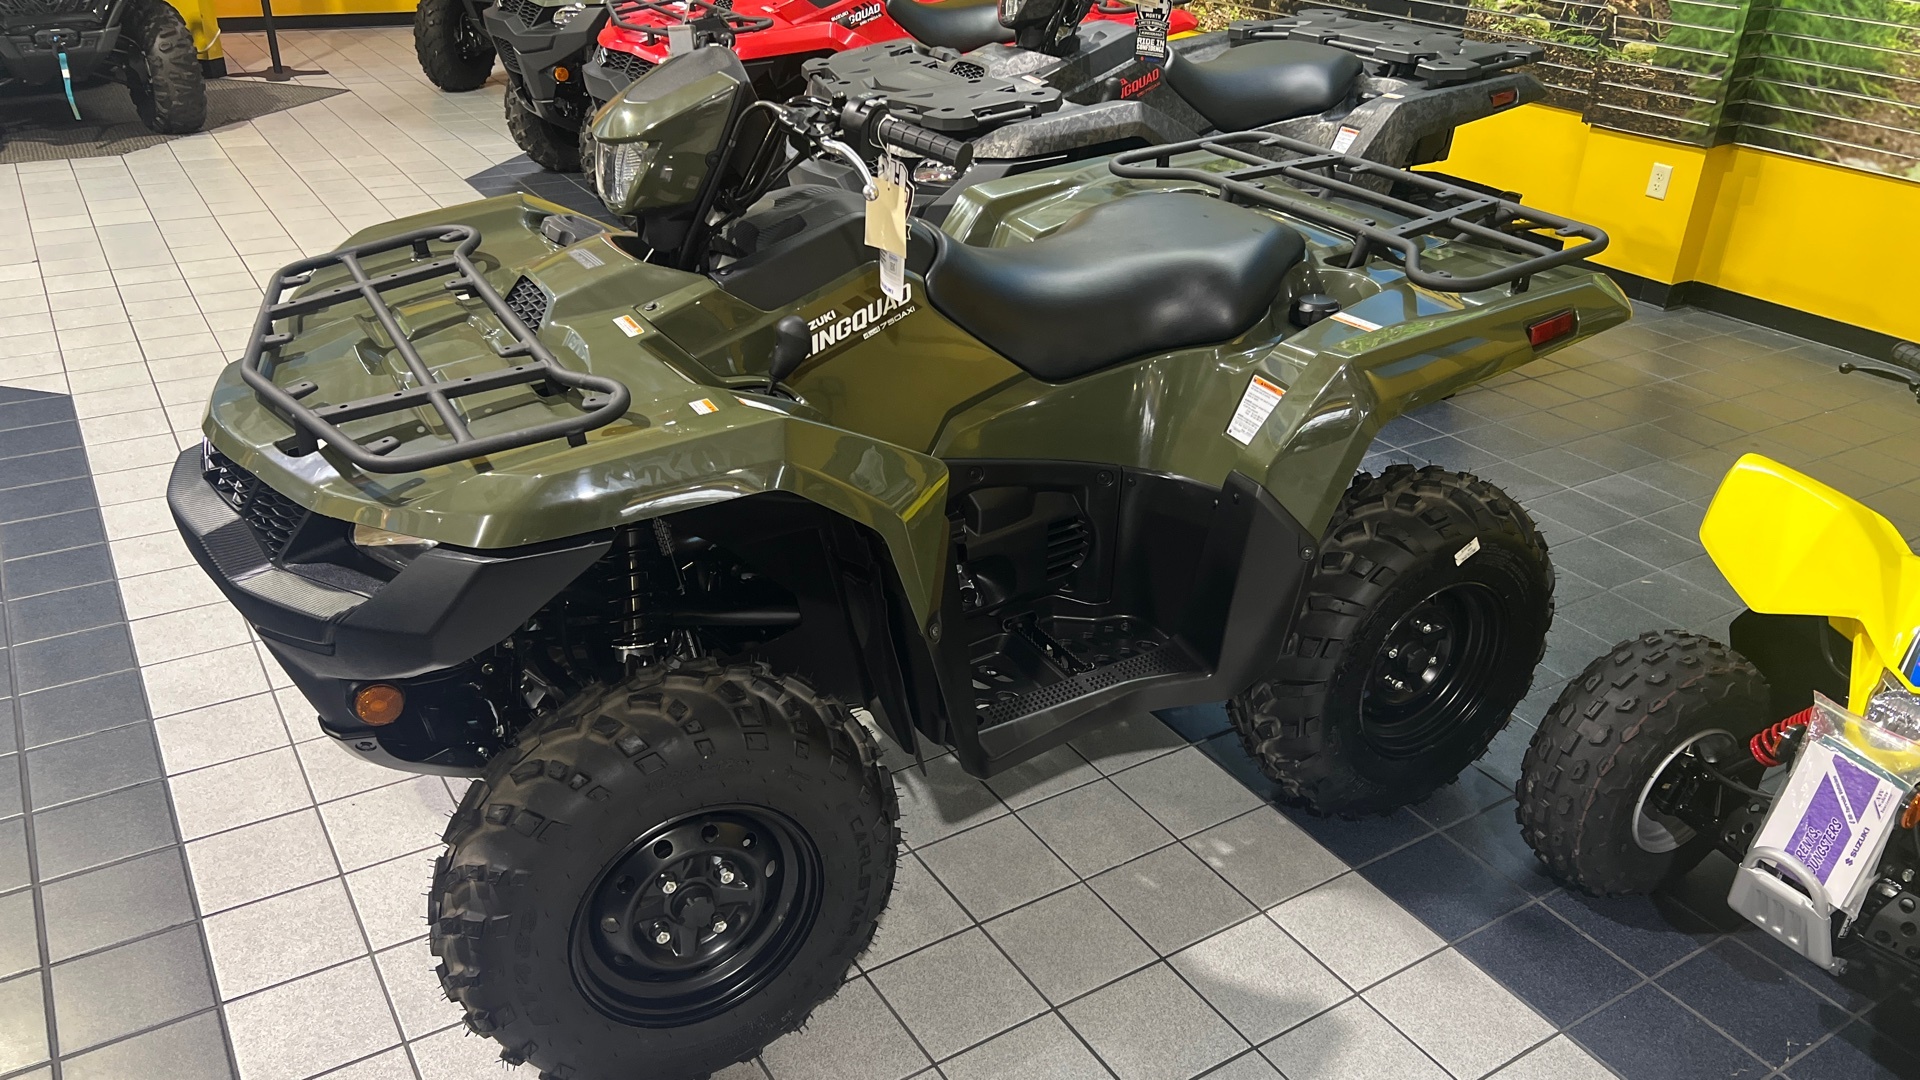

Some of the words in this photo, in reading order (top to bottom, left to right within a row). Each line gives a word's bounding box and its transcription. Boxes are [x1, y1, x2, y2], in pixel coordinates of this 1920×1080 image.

[848, 3, 880, 24] GQUAD
[1136, 37, 1155, 46] RIDE
[1157, 39, 1165, 47] IN
[1136, 44, 1165, 53] CONFIDENCE
[804, 282, 912, 360] INGQUAD
[808, 309, 837, 332] ZUKI
[1795, 827, 1822, 862] RENTS,
[1806, 818, 1842, 875] OUNGSTERS
[1850, 827, 1870, 858] SUZUKI
